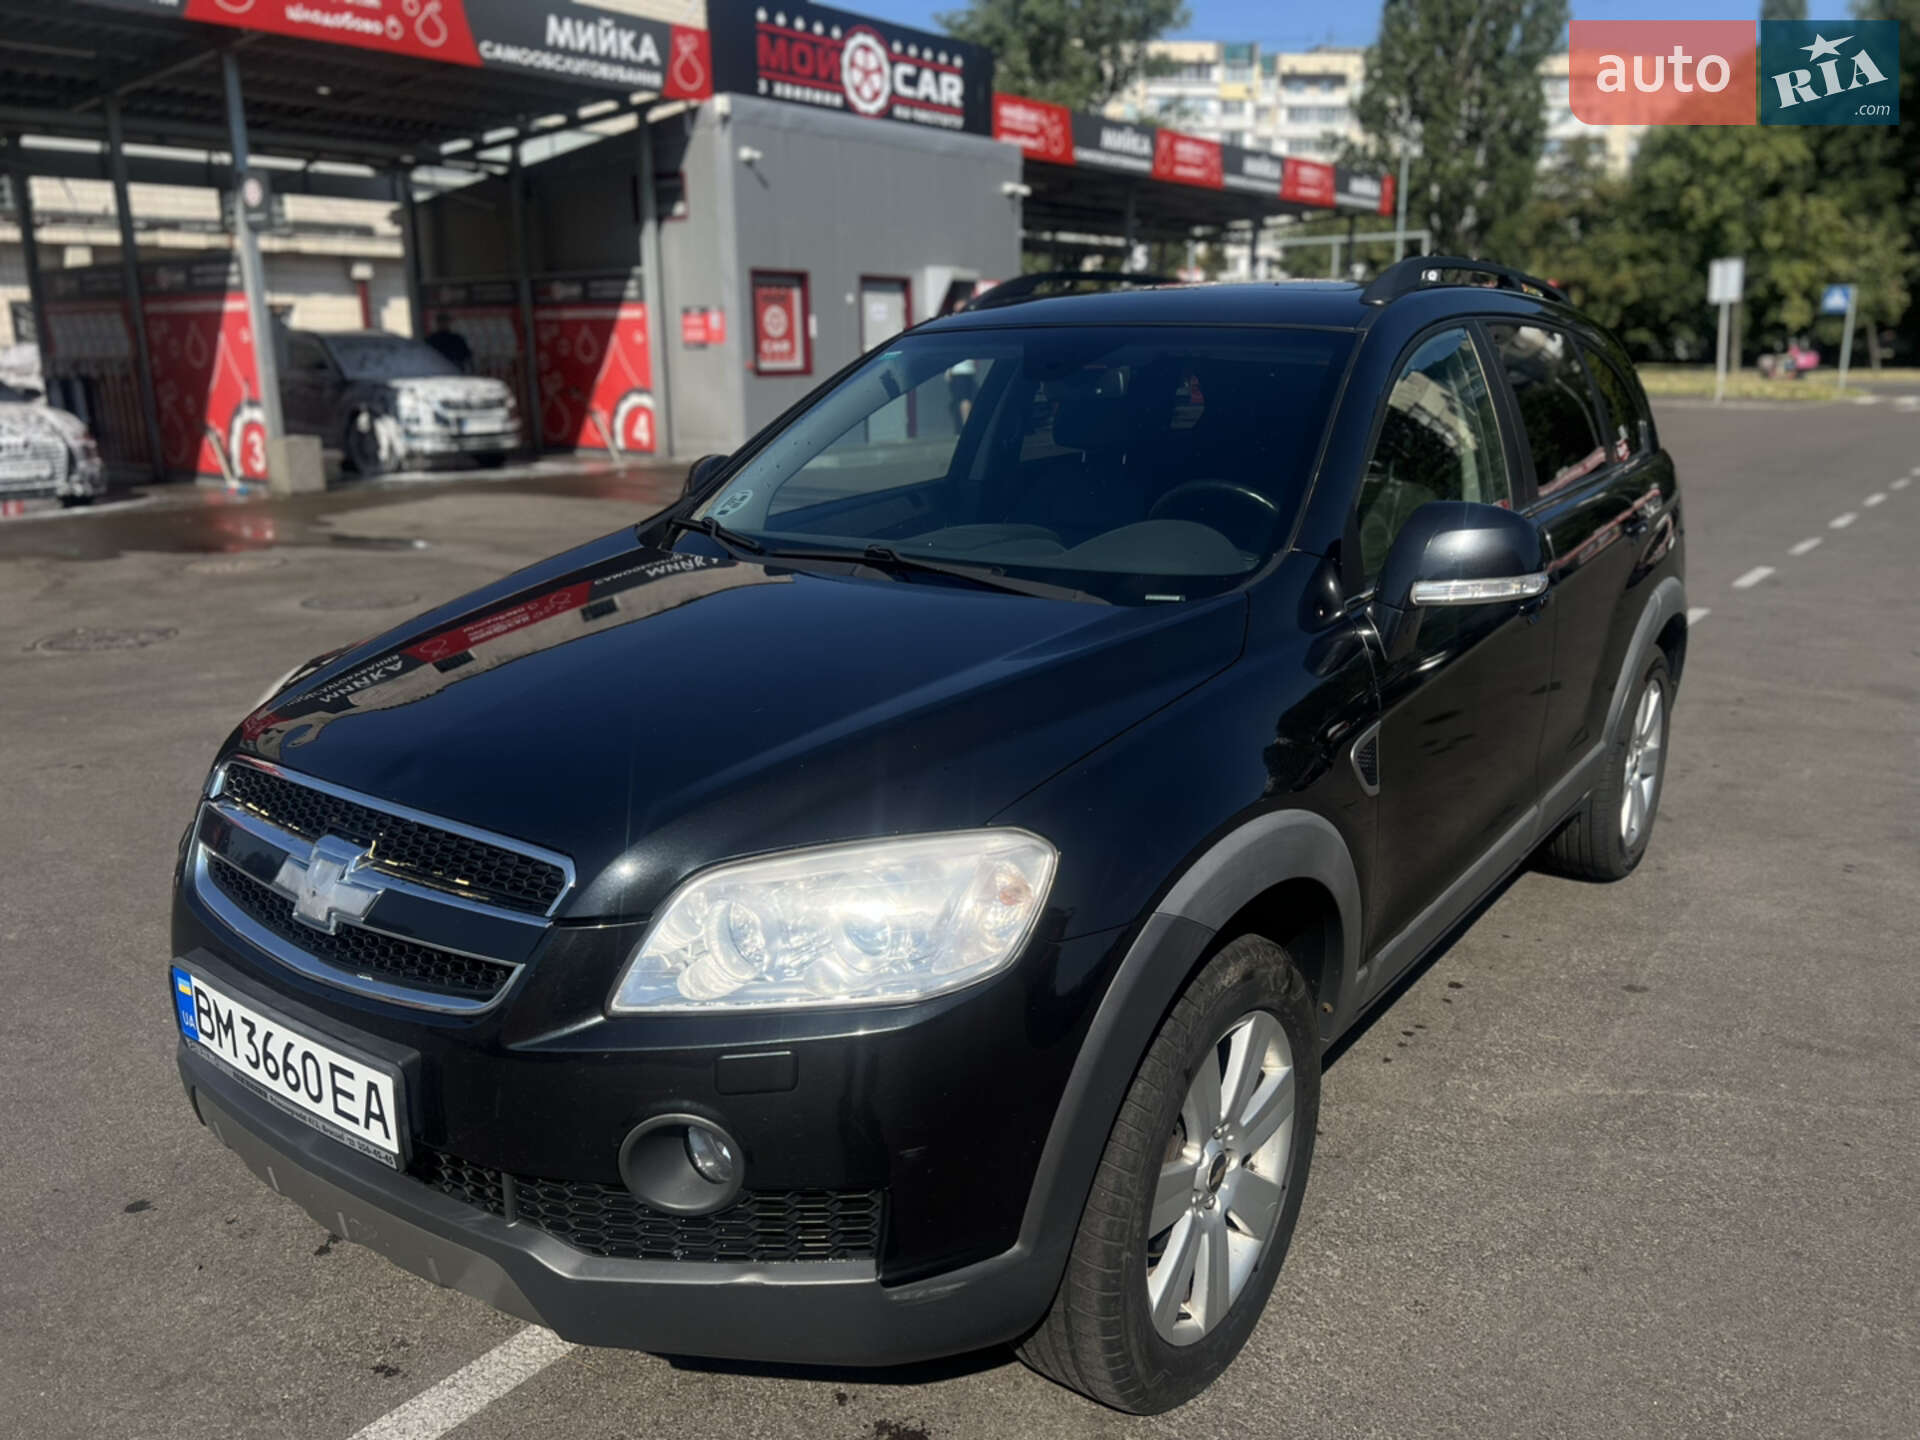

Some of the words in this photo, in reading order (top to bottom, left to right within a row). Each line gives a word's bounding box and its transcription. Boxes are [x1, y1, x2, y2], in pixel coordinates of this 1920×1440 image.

[545, 14, 661, 66] МИЙКА
[894, 62, 964, 109] CAR
[633, 412, 650, 446] 4
[248, 431, 266, 473] 3
[181, 1010, 196, 1028] UA
